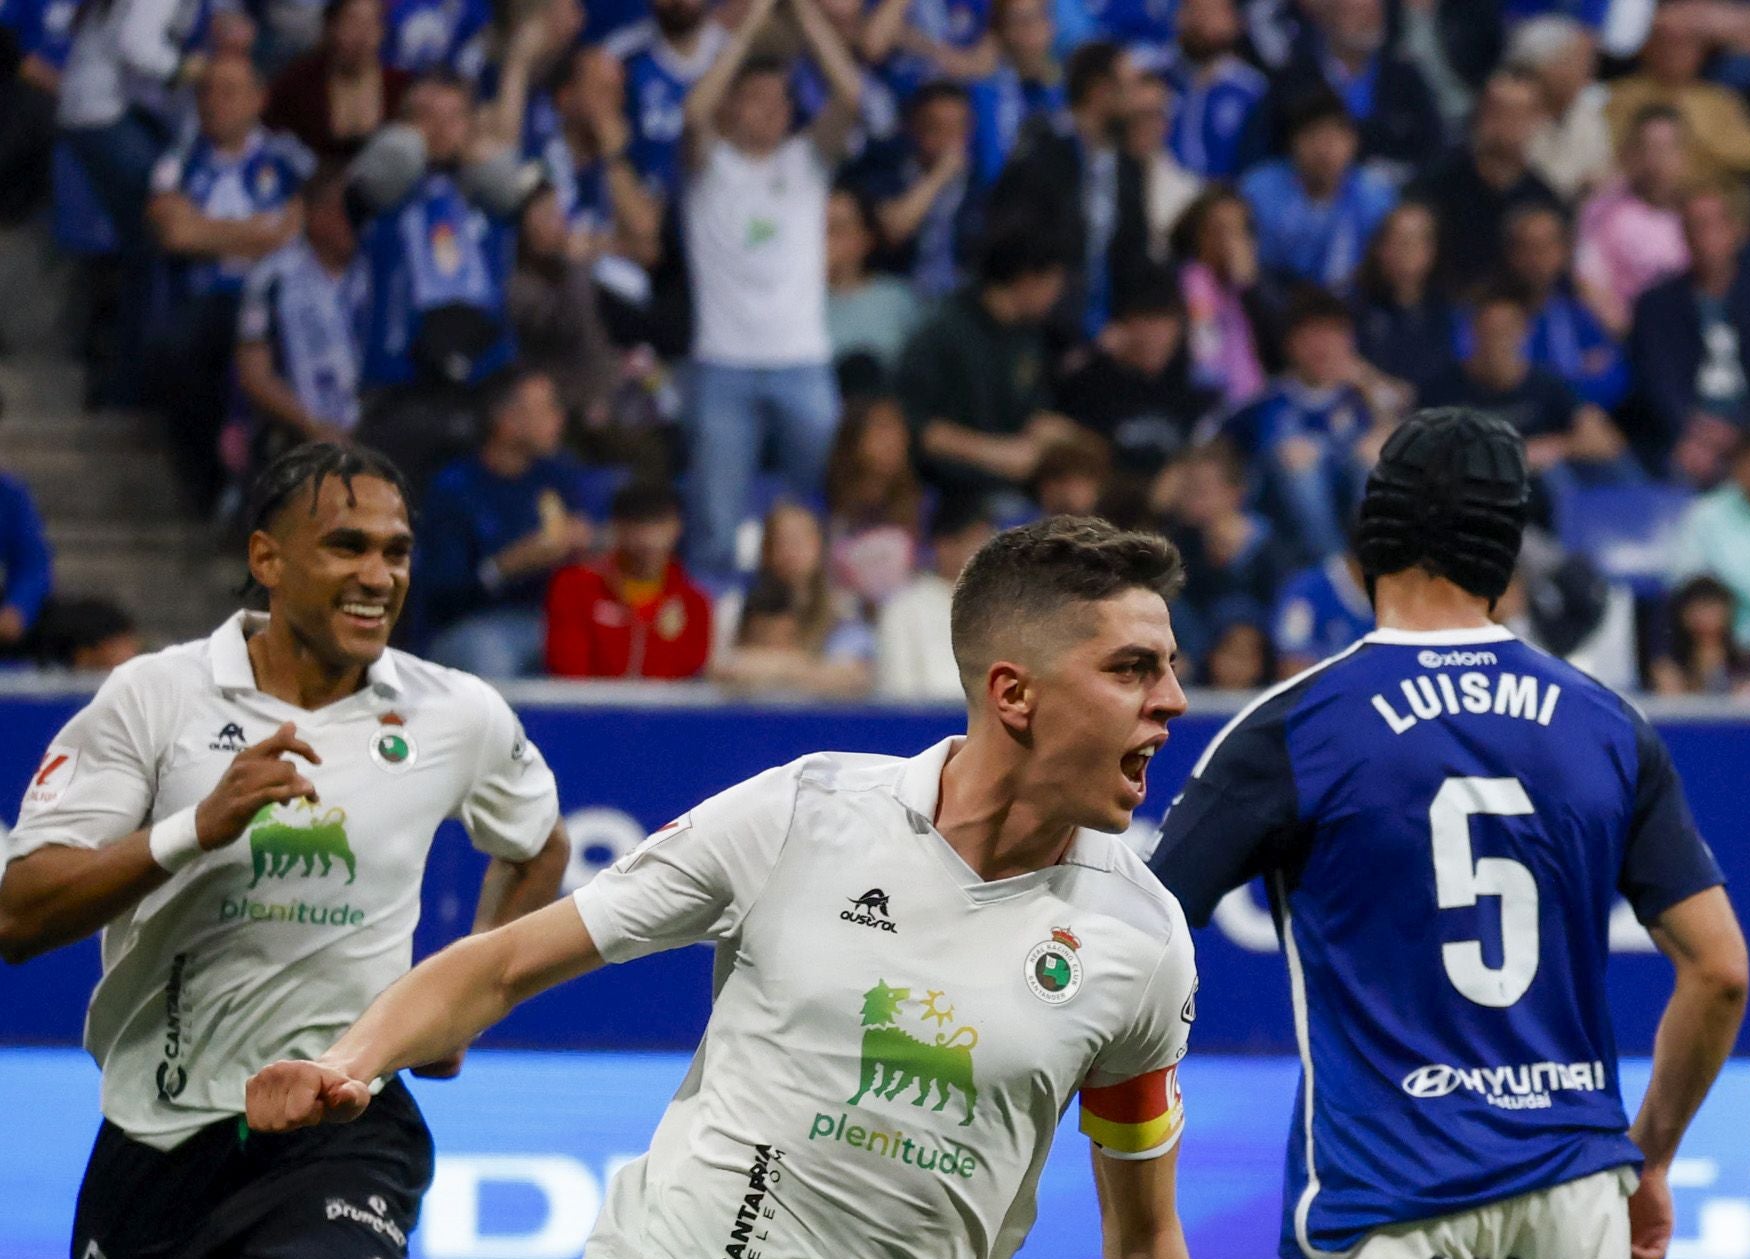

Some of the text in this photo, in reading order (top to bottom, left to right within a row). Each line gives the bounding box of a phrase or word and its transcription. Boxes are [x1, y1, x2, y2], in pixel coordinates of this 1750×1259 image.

[1371, 671, 1562, 735] LUISMI
[219, 899, 366, 927] plenitude
[1428, 776, 1541, 1008] 5
[840, 910, 898, 934] austral
[1456, 1059, 1606, 1095] HYUNDAI
[808, 1110, 977, 1179] plenitude
